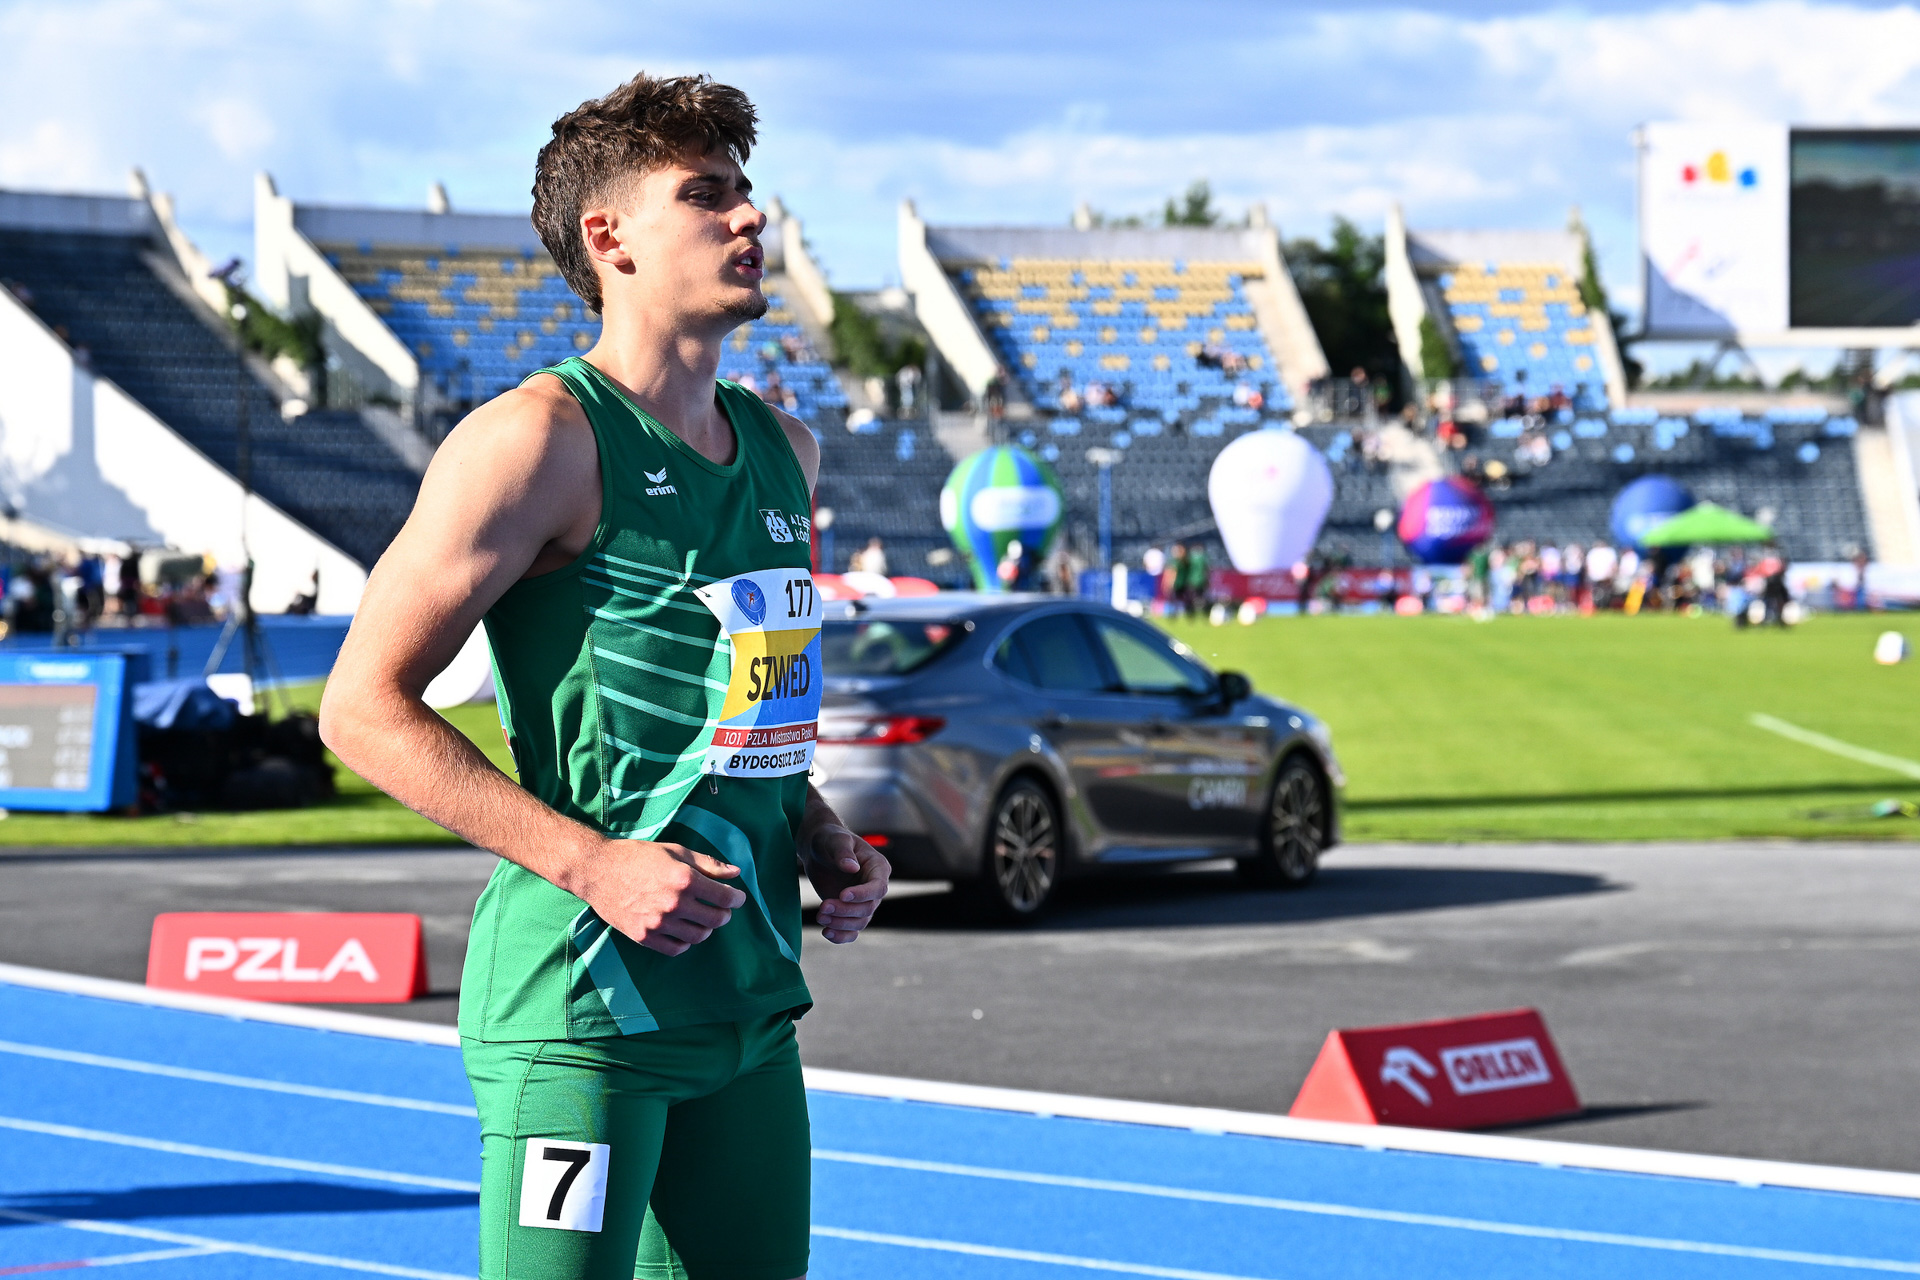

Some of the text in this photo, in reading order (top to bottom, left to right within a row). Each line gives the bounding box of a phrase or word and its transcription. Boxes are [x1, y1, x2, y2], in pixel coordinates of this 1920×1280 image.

[785, 579, 813, 617] 177
[747, 653, 810, 701] SZWED
[724, 732, 742, 745] 101.
[745, 732, 768, 745] PZLA
[729, 752, 791, 769] BYDGOSZCZ
[184, 937, 379, 983] PZLA
[1452, 1048, 1540, 1085] ORLEN
[543, 1147, 591, 1221] 7
